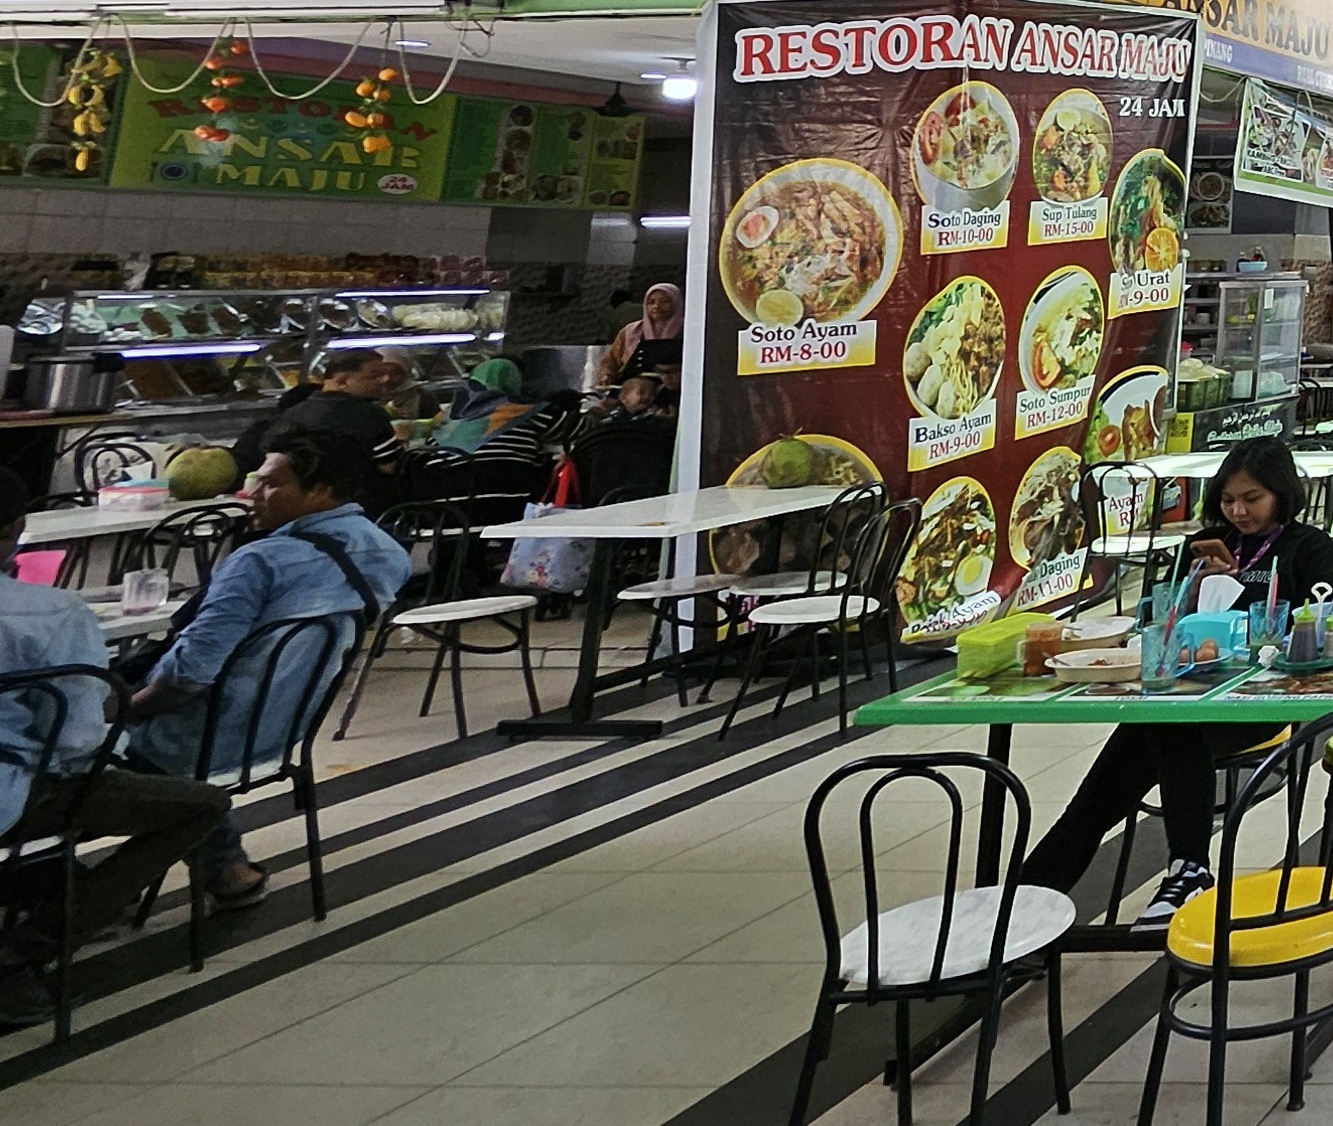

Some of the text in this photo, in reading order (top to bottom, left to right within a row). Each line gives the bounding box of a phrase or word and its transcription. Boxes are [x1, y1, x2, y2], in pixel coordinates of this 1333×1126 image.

[1264, 1, 1333, 62] MAJU
[737, 16, 1190, 80] RESTORAN ANSAR MAJU
[1119, 97, 1143, 117] 24
[216, 163, 367, 192] MAJU
[928, 210, 1001, 228] Soto Daging
[1042, 205, 1097, 222] Sup Tulang
[937, 228, 994, 247] RM-10-00
[1043, 222, 1094, 237] RM-15-00
[1137, 270, 1170, 287] Urat
[750, 323, 858, 344] Soto Ayam
[760, 340, 847, 364] RM-8-00
[1019, 397, 1046, 414] Soto
[1026, 401, 1084, 429] RM-12-00
[914, 412, 993, 445] Bakso Ayam
[928, 432, 981, 461] RM-9-00
[1108, 493, 1144, 513] Ayam
[1040, 555, 1080, 578] Daging
[1017, 573, 1073, 607] RM-11-00
